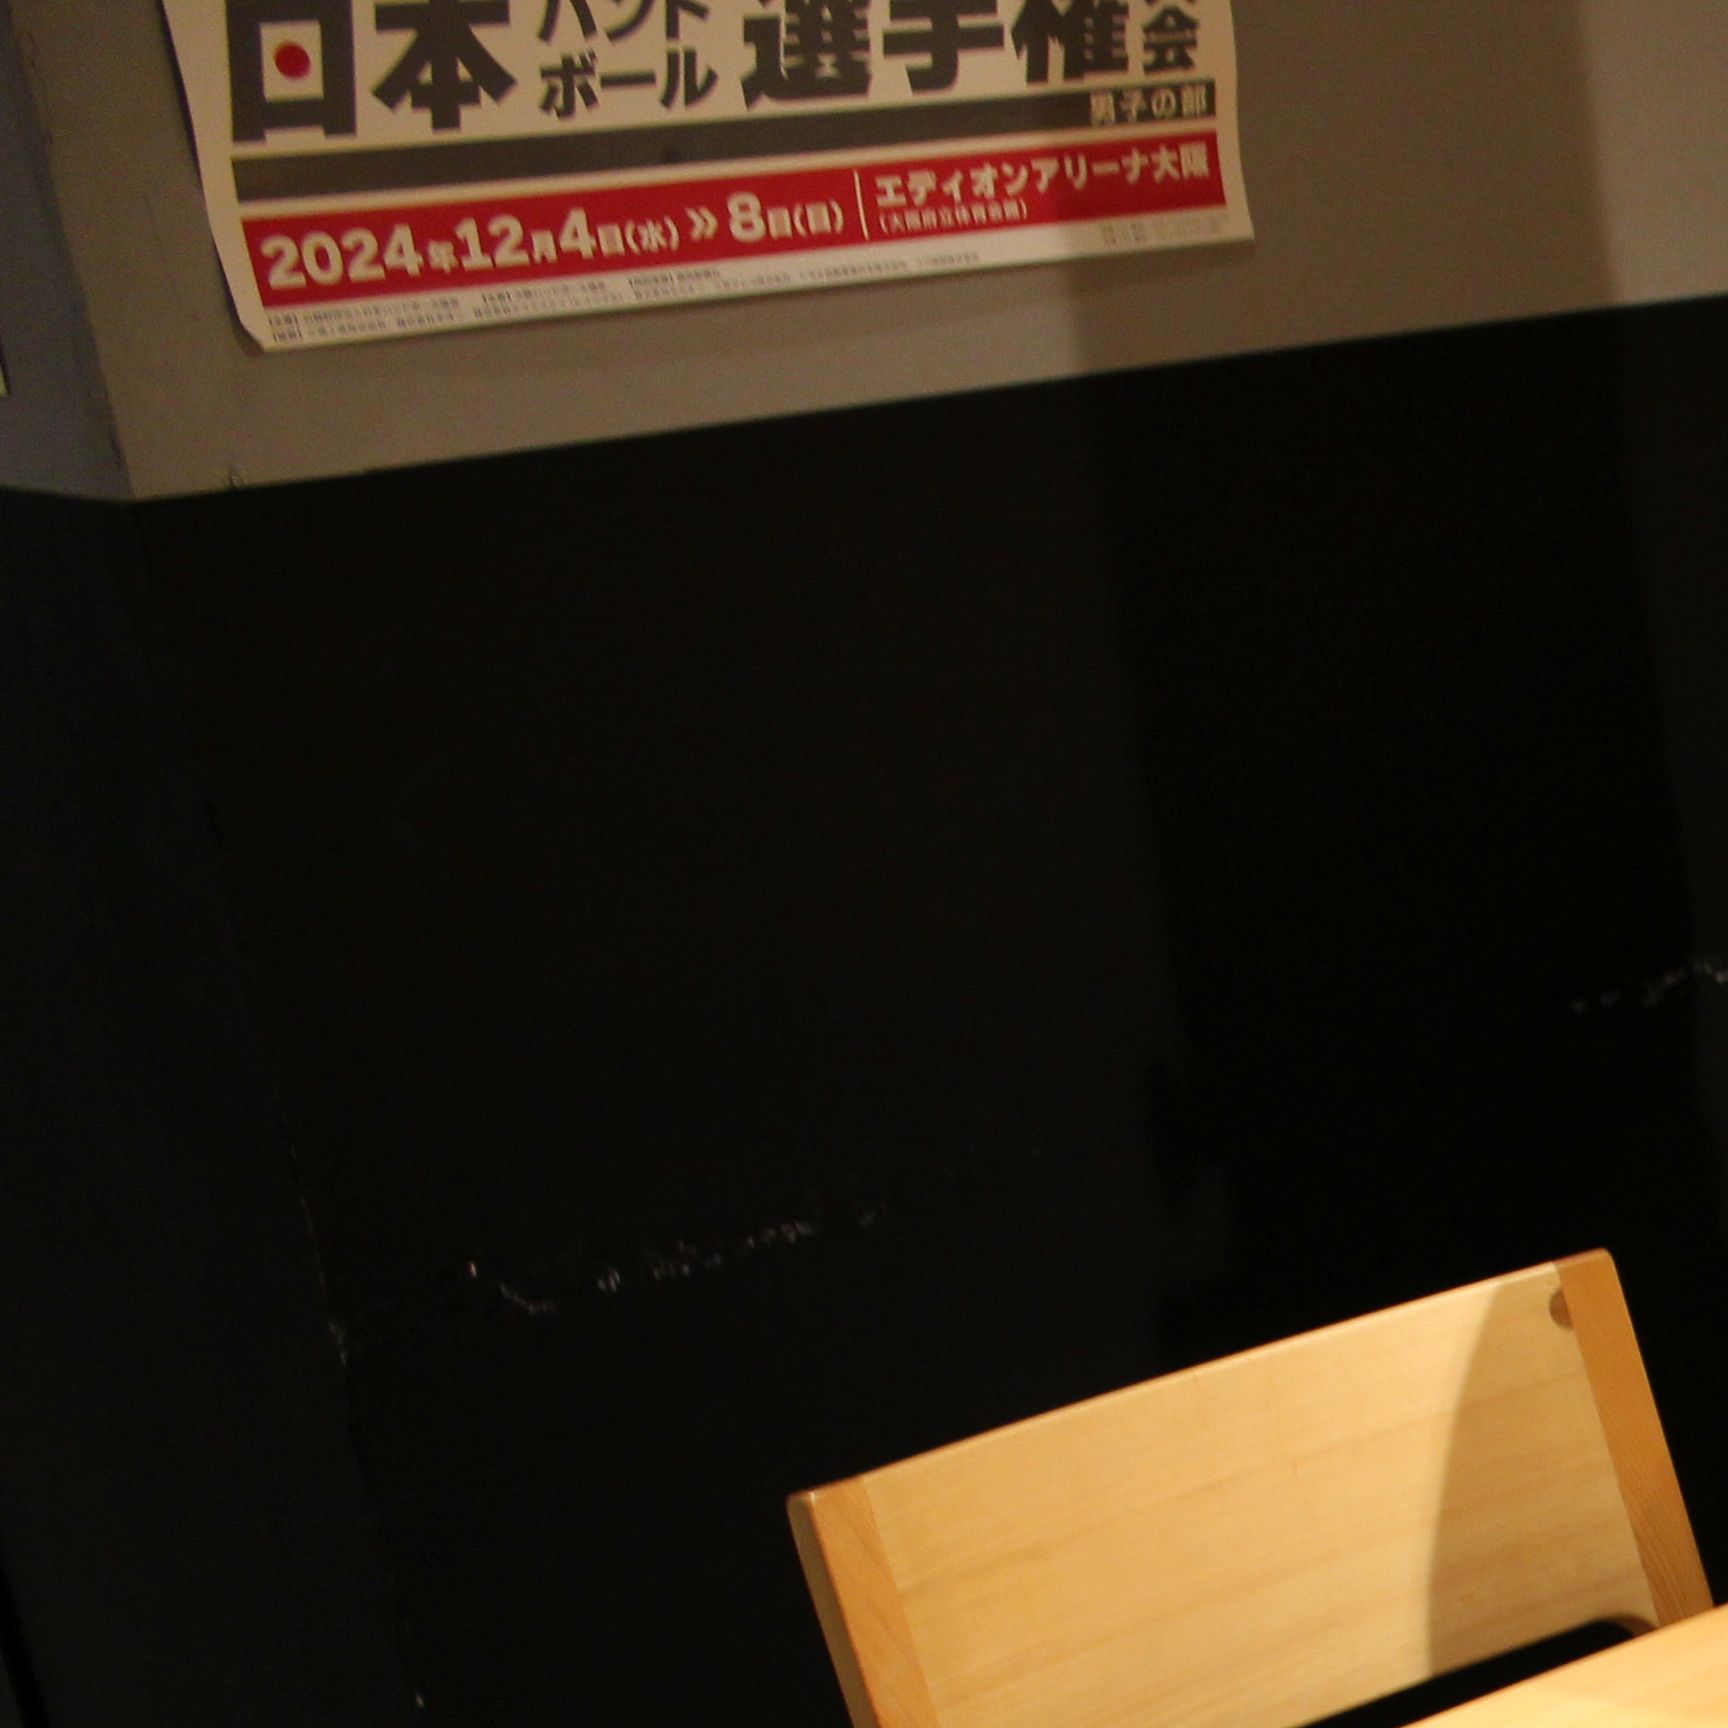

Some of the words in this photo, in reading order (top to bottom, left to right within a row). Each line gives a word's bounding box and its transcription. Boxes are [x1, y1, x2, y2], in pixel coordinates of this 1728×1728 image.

[874, 141, 1210, 209] エディオンアリーナ大阪
